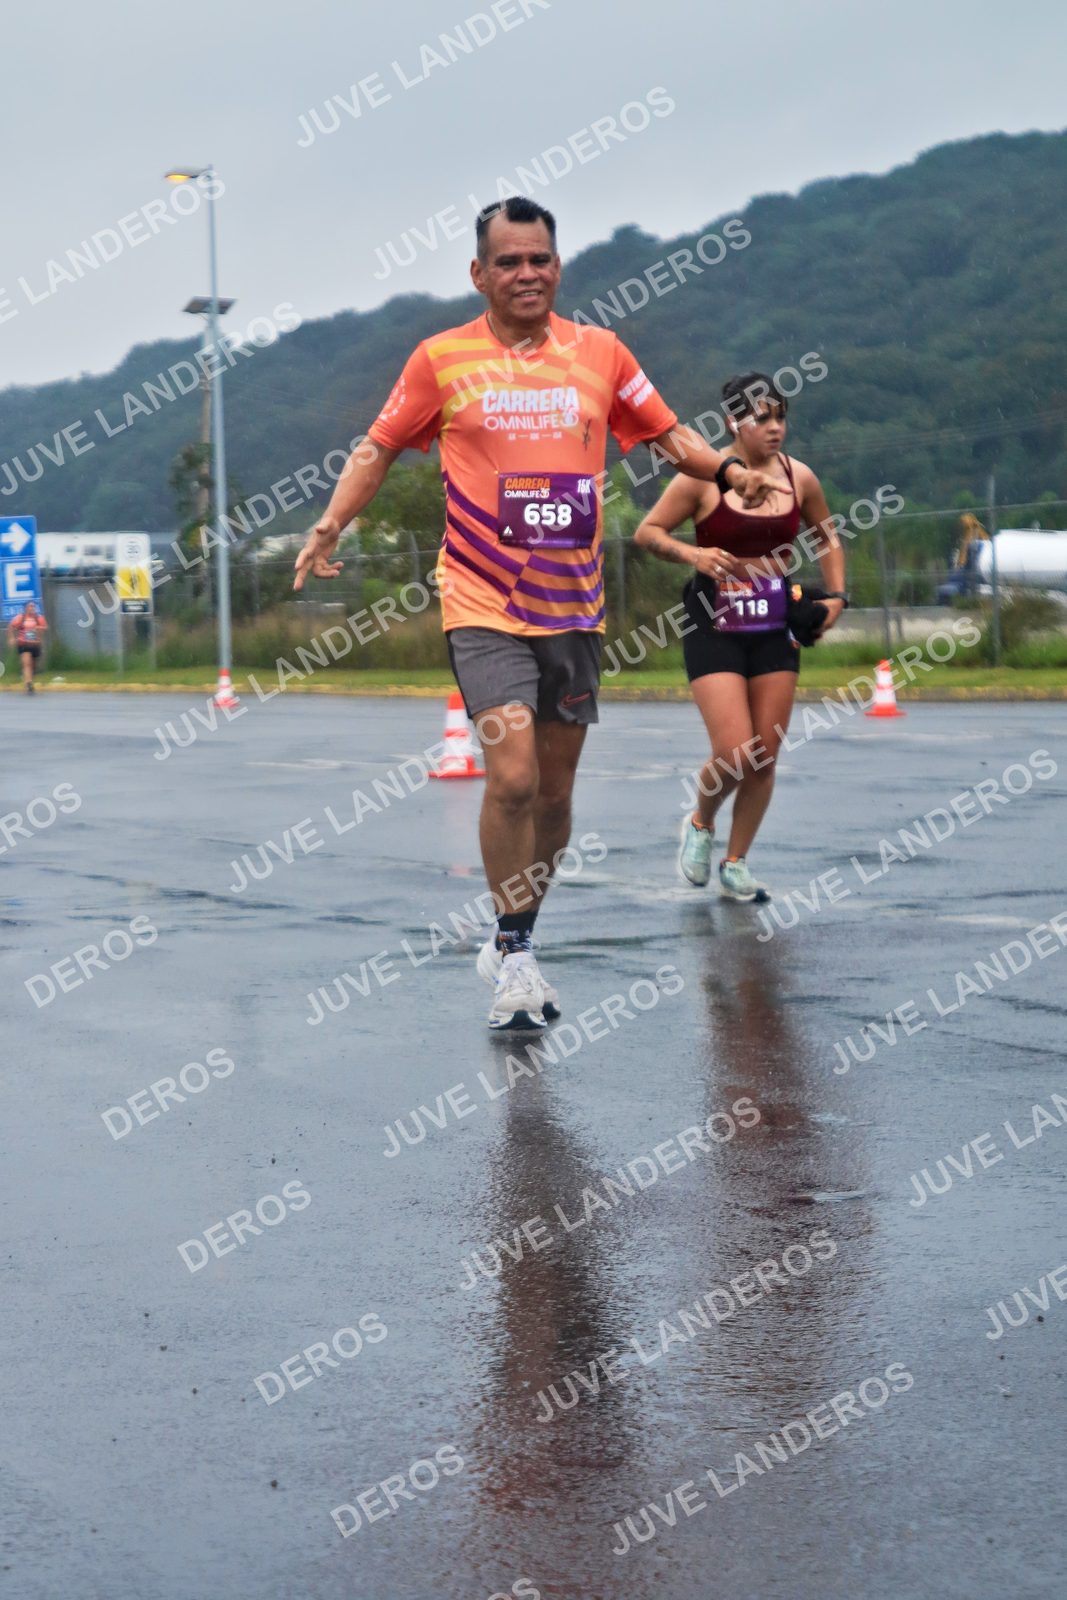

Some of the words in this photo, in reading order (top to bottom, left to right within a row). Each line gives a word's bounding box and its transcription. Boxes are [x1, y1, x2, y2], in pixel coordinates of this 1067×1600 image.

[482, 386, 580, 413] CARRERA
[484, 413, 560, 430] OMNILIFE
[504, 478, 550, 489] CARRERA
[504, 490, 540, 498] OMNILIFE
[524, 503, 572, 526] 658
[6, 562, 34, 598] E
[735, 599, 769, 616] 118
